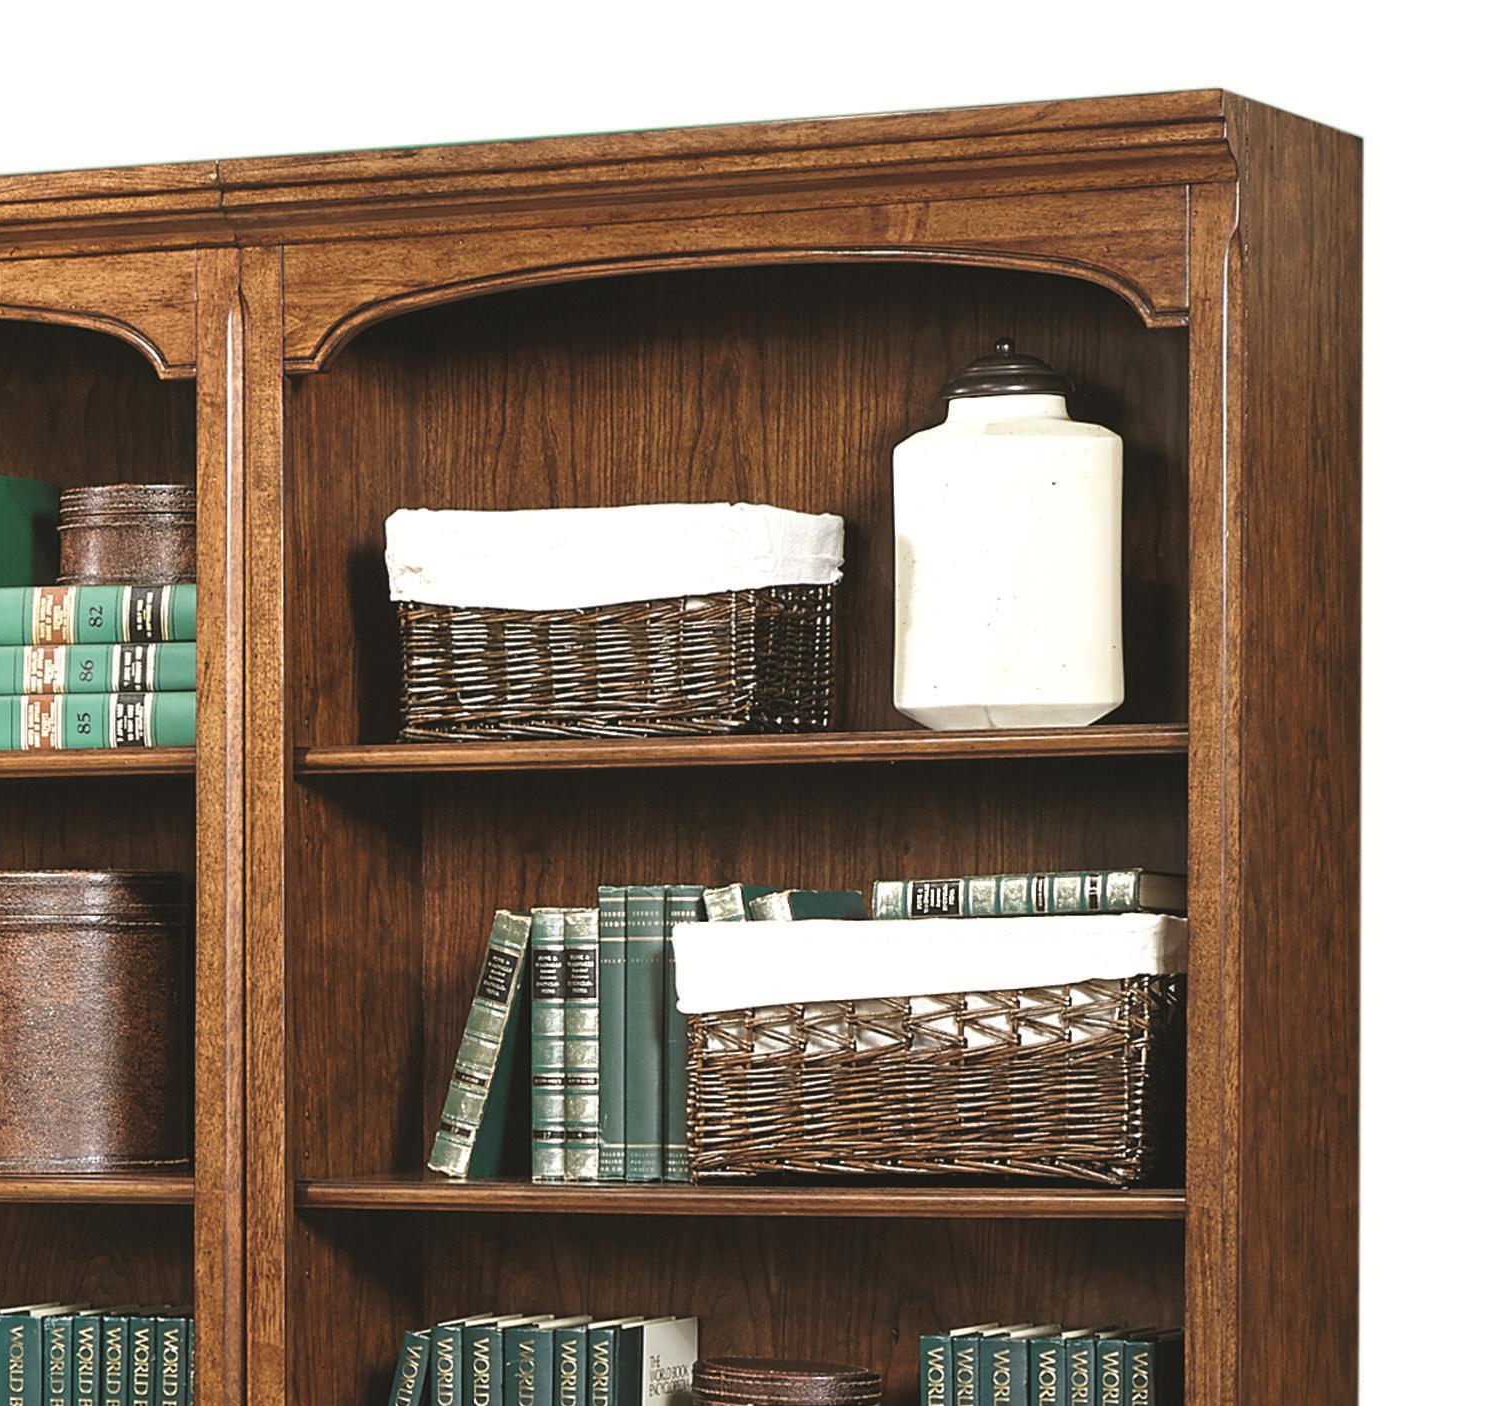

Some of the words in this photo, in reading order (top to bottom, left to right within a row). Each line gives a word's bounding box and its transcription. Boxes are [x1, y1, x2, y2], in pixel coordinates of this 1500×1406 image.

[89, 605, 103, 628] 82
[79, 660, 94, 682] 86
[77, 712, 91, 735] 85
[9, 1325, 24, 1392] WORLD
[50, 1327, 65, 1394] WORLD
[77, 1326, 94, 1394] WORLD
[105, 1327, 122, 1394] WORLD
[132, 1328, 149, 1396] WORLD
[161, 1329, 179, 1396] WORLD
[437, 1338, 454, 1406] WORLD
